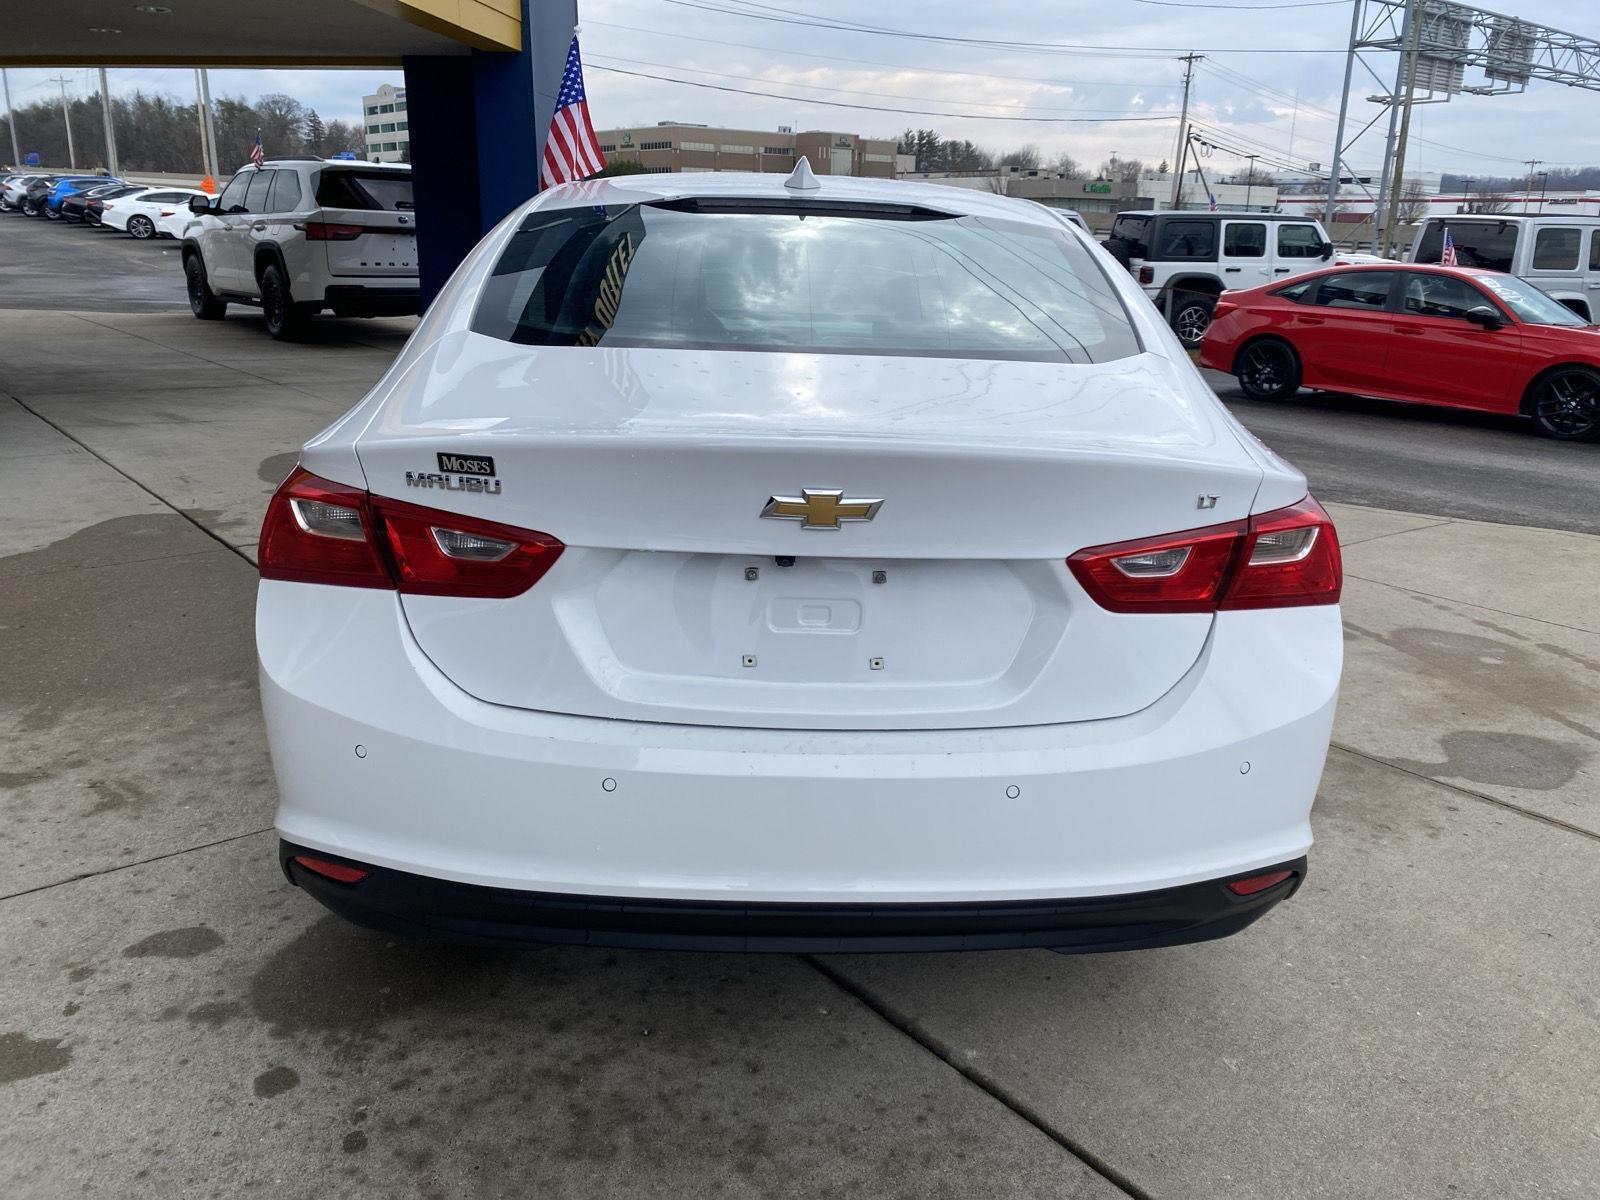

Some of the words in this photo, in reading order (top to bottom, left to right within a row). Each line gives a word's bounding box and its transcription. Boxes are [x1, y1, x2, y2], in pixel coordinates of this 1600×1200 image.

[441, 455, 491, 474] MOSES
[405, 471, 502, 495] MALIBU
[1197, 494, 1221, 510] LT
